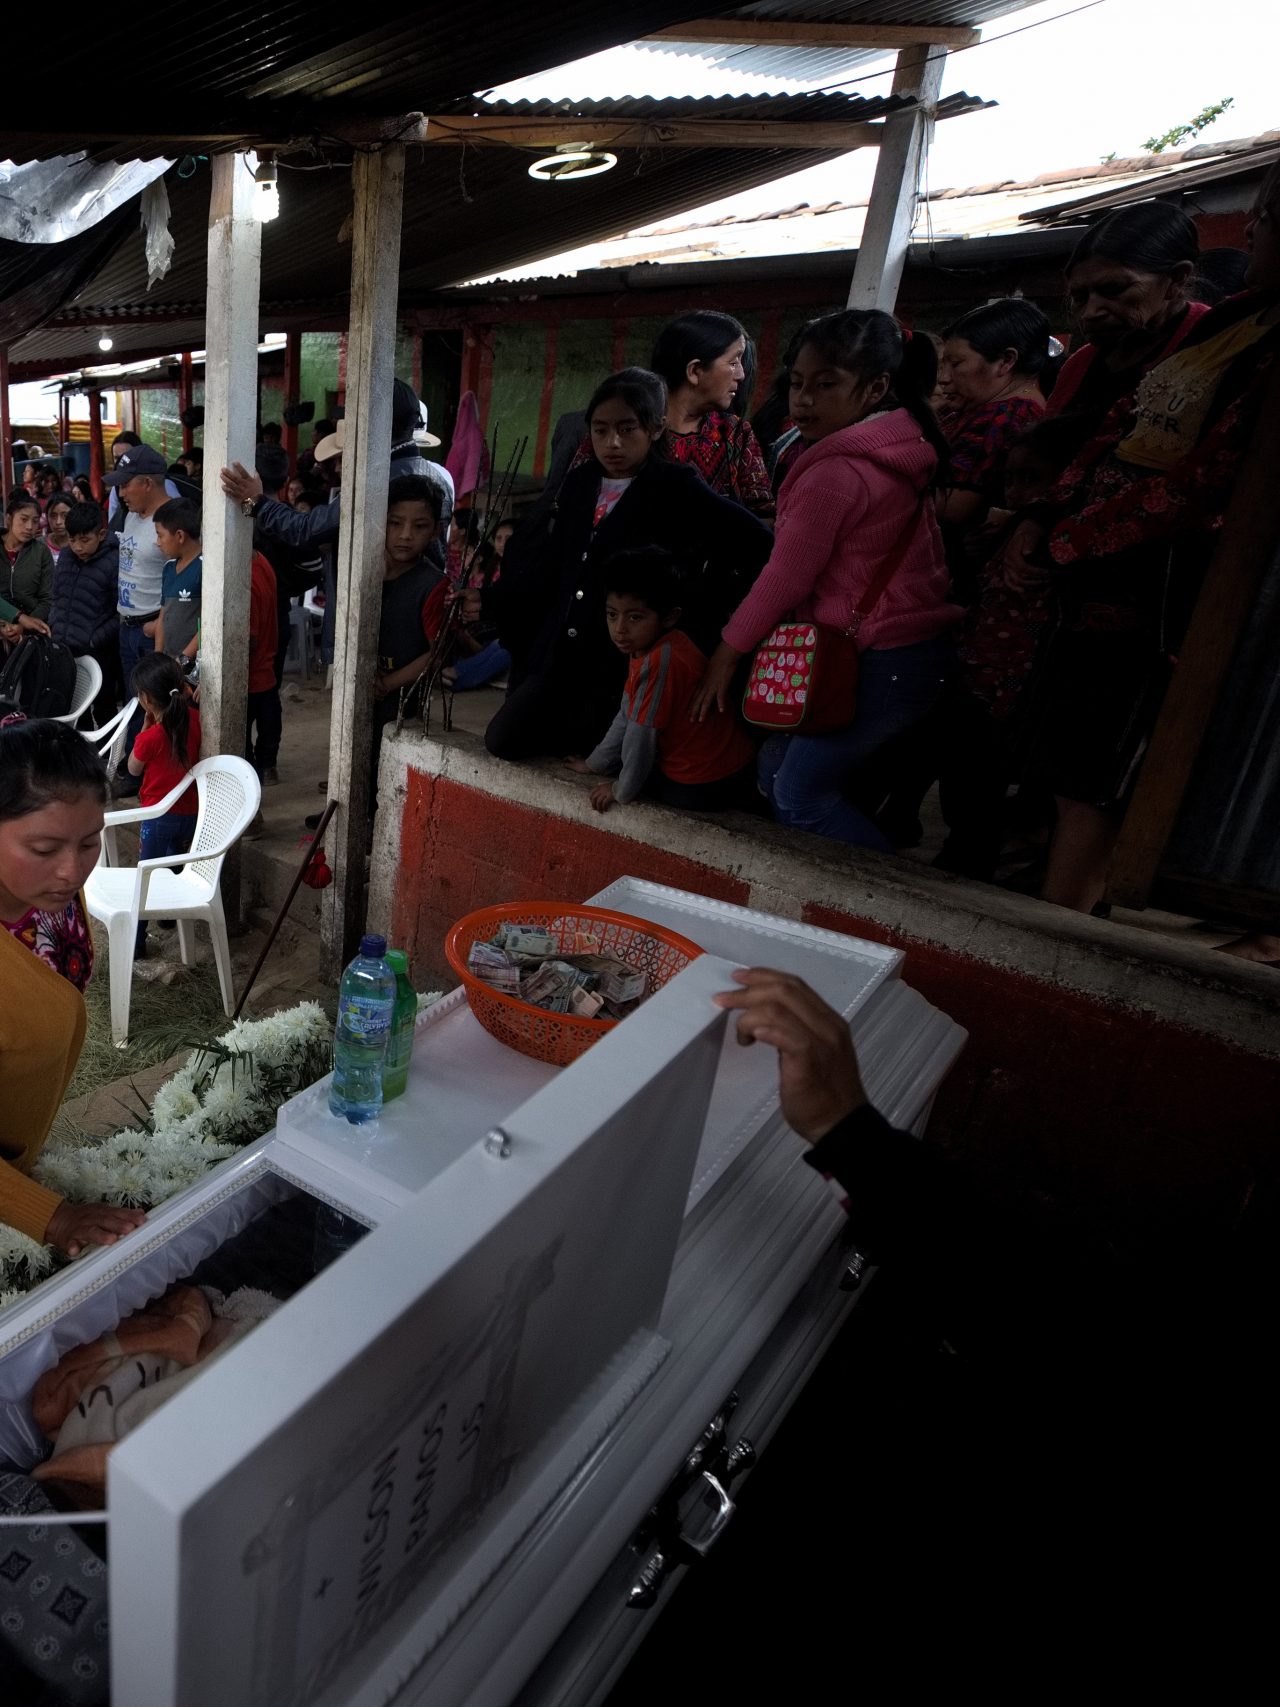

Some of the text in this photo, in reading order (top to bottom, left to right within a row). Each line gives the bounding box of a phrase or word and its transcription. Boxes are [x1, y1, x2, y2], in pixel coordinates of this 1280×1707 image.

[1168, 392, 1185, 411] U
[355, 1447, 402, 1617] WILSON
[404, 1402, 449, 1554] RAMOS
